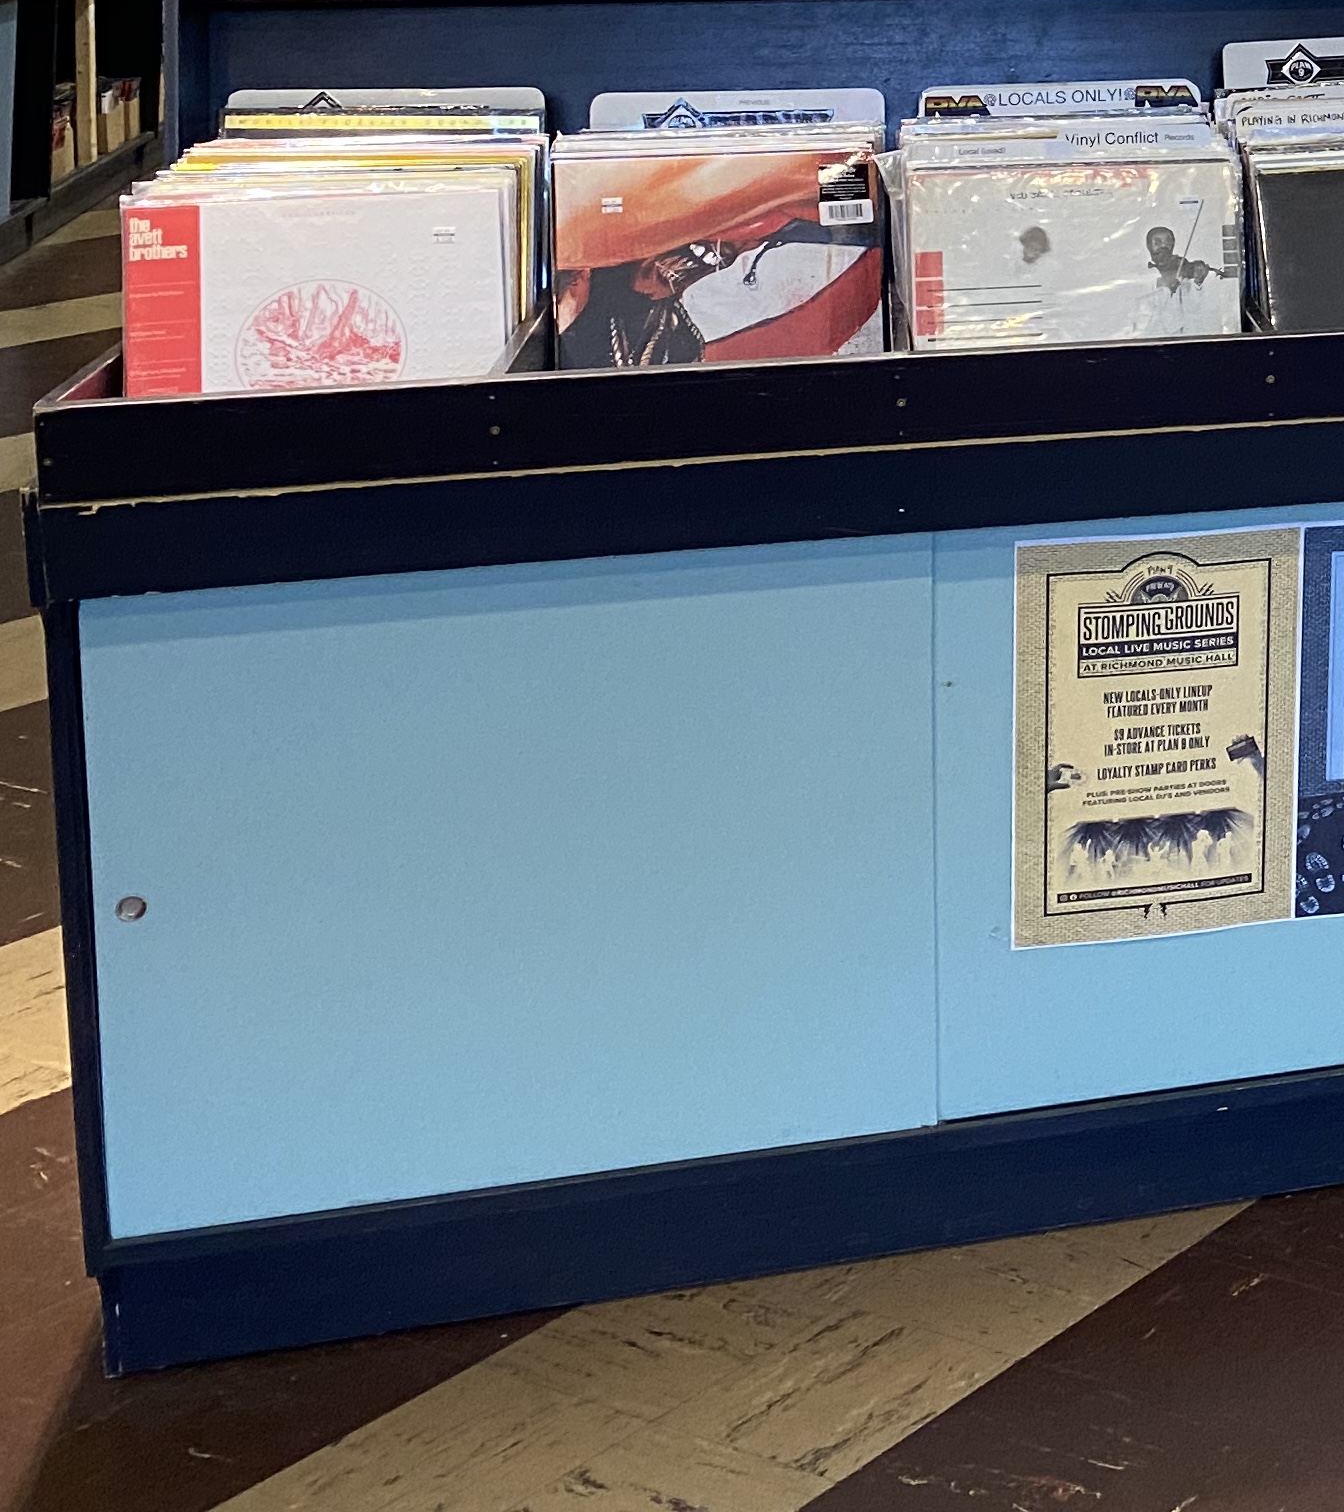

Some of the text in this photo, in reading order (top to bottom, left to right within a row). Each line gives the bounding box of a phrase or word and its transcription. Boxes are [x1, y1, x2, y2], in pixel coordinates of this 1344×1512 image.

[998, 91, 1066, 107] LOCALS
[1072, 88, 1123, 104] ONLY!
[1241, 115, 1283, 128] PLAYING
[1287, 114, 1297, 126] IN
[1065, 132, 1101, 147] Vinyl
[1105, 130, 1159, 145] Conflict
[129, 217, 151, 234] the
[129, 229, 163, 246] avett
[129, 242, 188, 262] brothers
[1083, 601, 1235, 641] STOMPING GROUNDS
[1082, 636, 1234, 657] LOCAL LIVE MUSIC SERIES
[1083, 652, 1234, 673] AT RICHMOND MUSIC HALL
[1103, 685, 1213, 704] NEW LOCALS-ONLY LINEUP
[1107, 699, 1209, 718] FEATURED EVERY MONTH
[1127, 725, 1165, 740] ADVANCE
[1167, 723, 1201, 736] TICKETS
[1104, 742, 1142, 757] IN-STORE
[1144, 741, 1155, 754] AT
[1157, 739, 1179, 752] PLAN
[1188, 736, 1210, 749] ONLY
[1097, 758, 1217, 781] LOYALTY STAMP CARD PERKS
